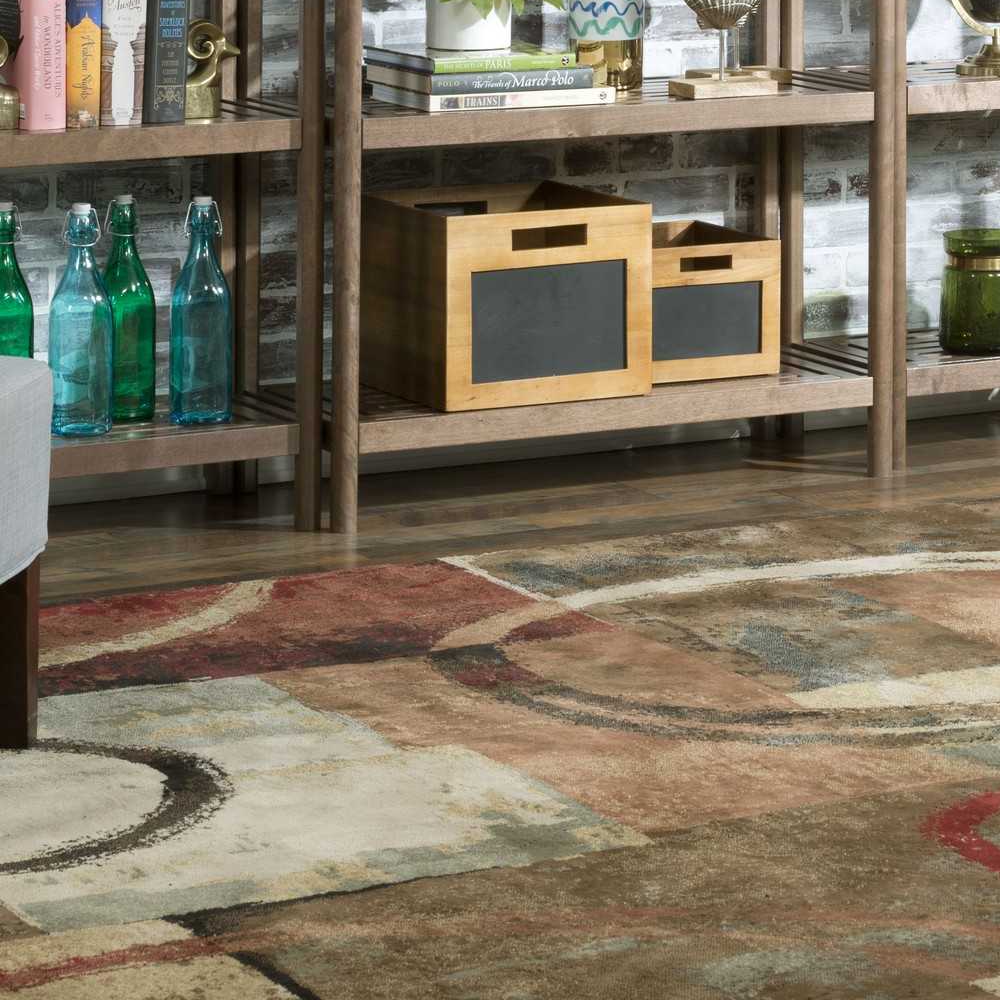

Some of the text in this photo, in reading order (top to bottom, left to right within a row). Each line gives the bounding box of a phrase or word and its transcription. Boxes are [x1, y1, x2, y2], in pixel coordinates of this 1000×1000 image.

[485, 59, 512, 70] PARIS
[438, 80, 460, 88] POLO
[511, 73, 547, 88] Marco
[546, 70, 574, 86] Polo
[466, 96, 498, 107] TRAINS
